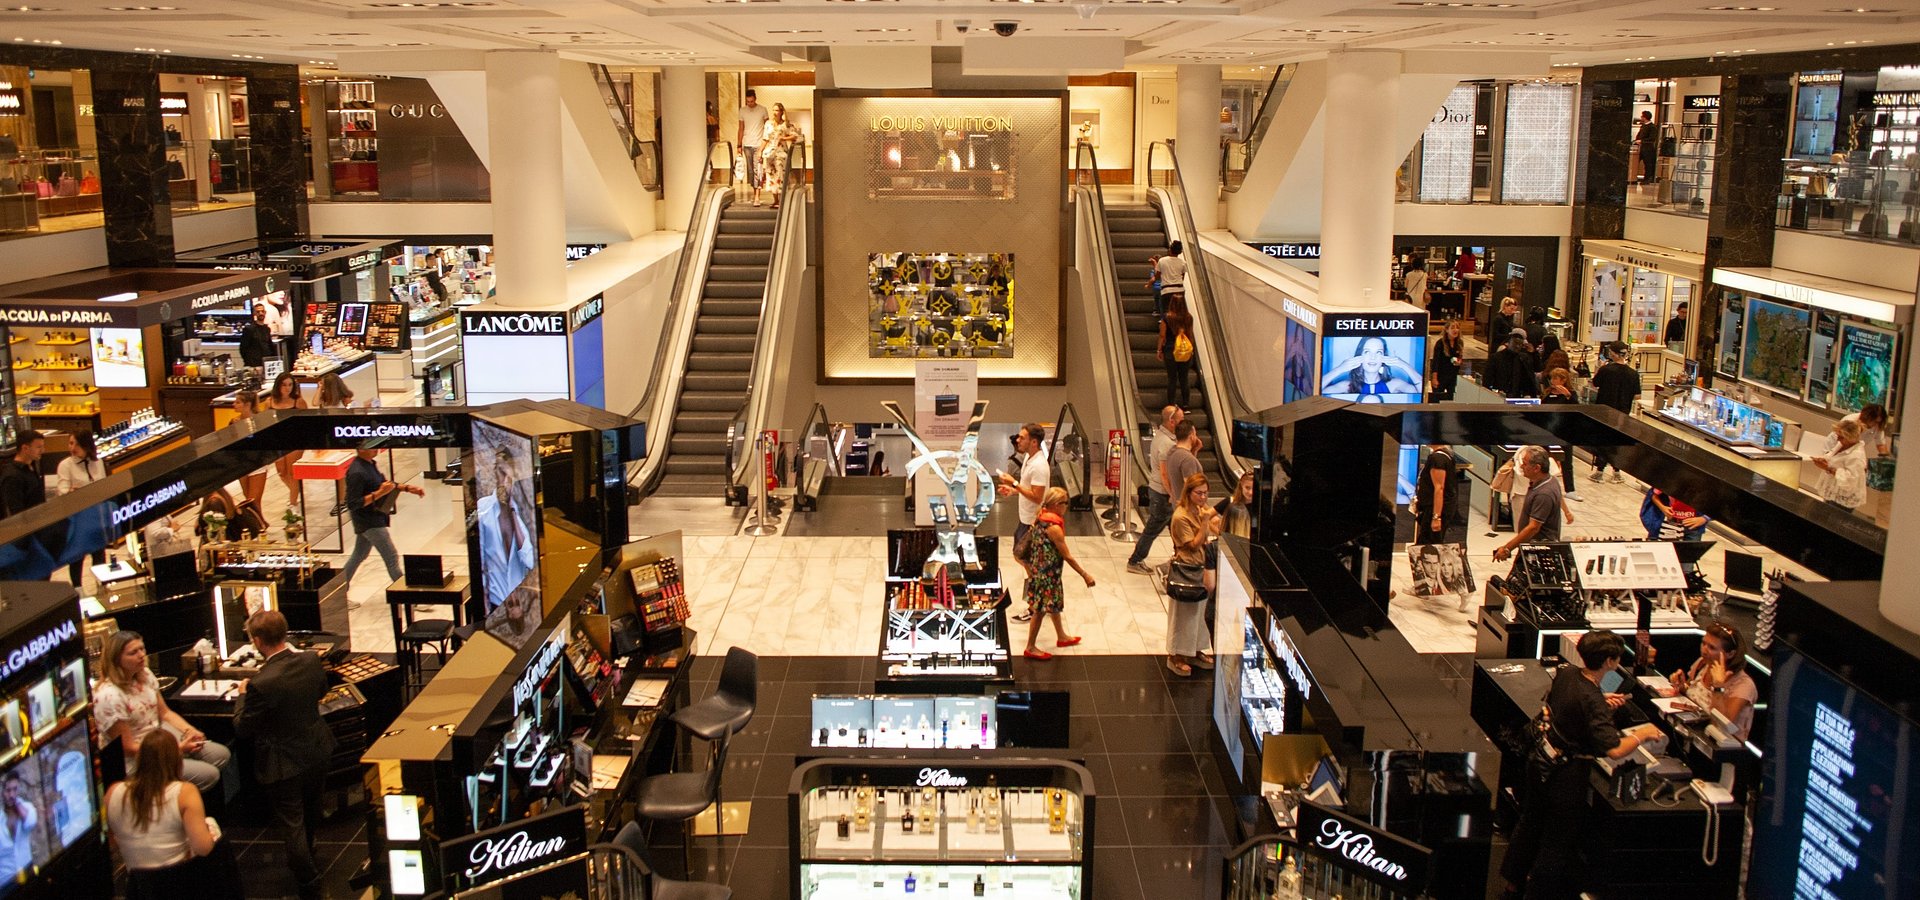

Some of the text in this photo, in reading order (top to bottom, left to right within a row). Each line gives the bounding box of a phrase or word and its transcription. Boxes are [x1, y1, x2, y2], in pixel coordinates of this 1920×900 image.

[1151, 95, 1170, 105] Dior
[870, 115, 1013, 132] LOUIS VUITTON
[191, 293, 219, 310] ACQUA
[224, 286, 251, 300] PARMA
[0, 309, 49, 323] ACQUA
[62, 310, 114, 323] PARMA
[465, 313, 564, 334] LANCÔME
[1370, 319, 1415, 331] LAUDER
[465, 831, 567, 878] Kilian
[1316, 817, 1408, 881] Kilian
